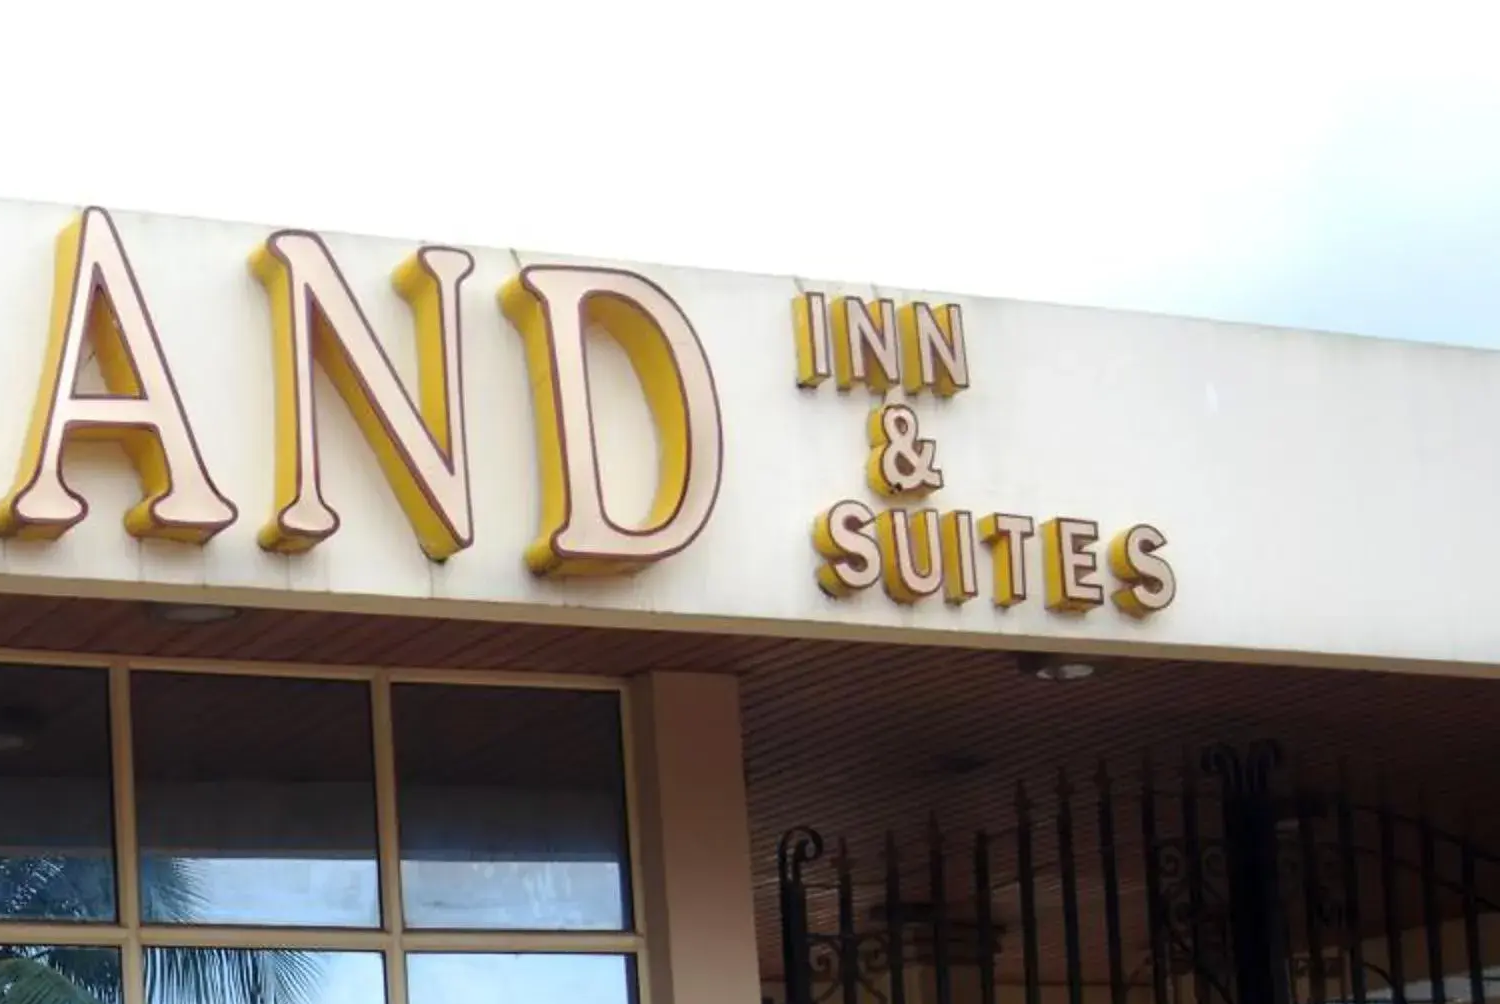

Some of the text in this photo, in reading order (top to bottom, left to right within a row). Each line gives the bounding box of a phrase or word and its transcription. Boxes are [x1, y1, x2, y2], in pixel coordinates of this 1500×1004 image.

[793, 291, 970, 396] INN
[867, 403, 944, 499] &
[812, 499, 1178, 619] SUITES
